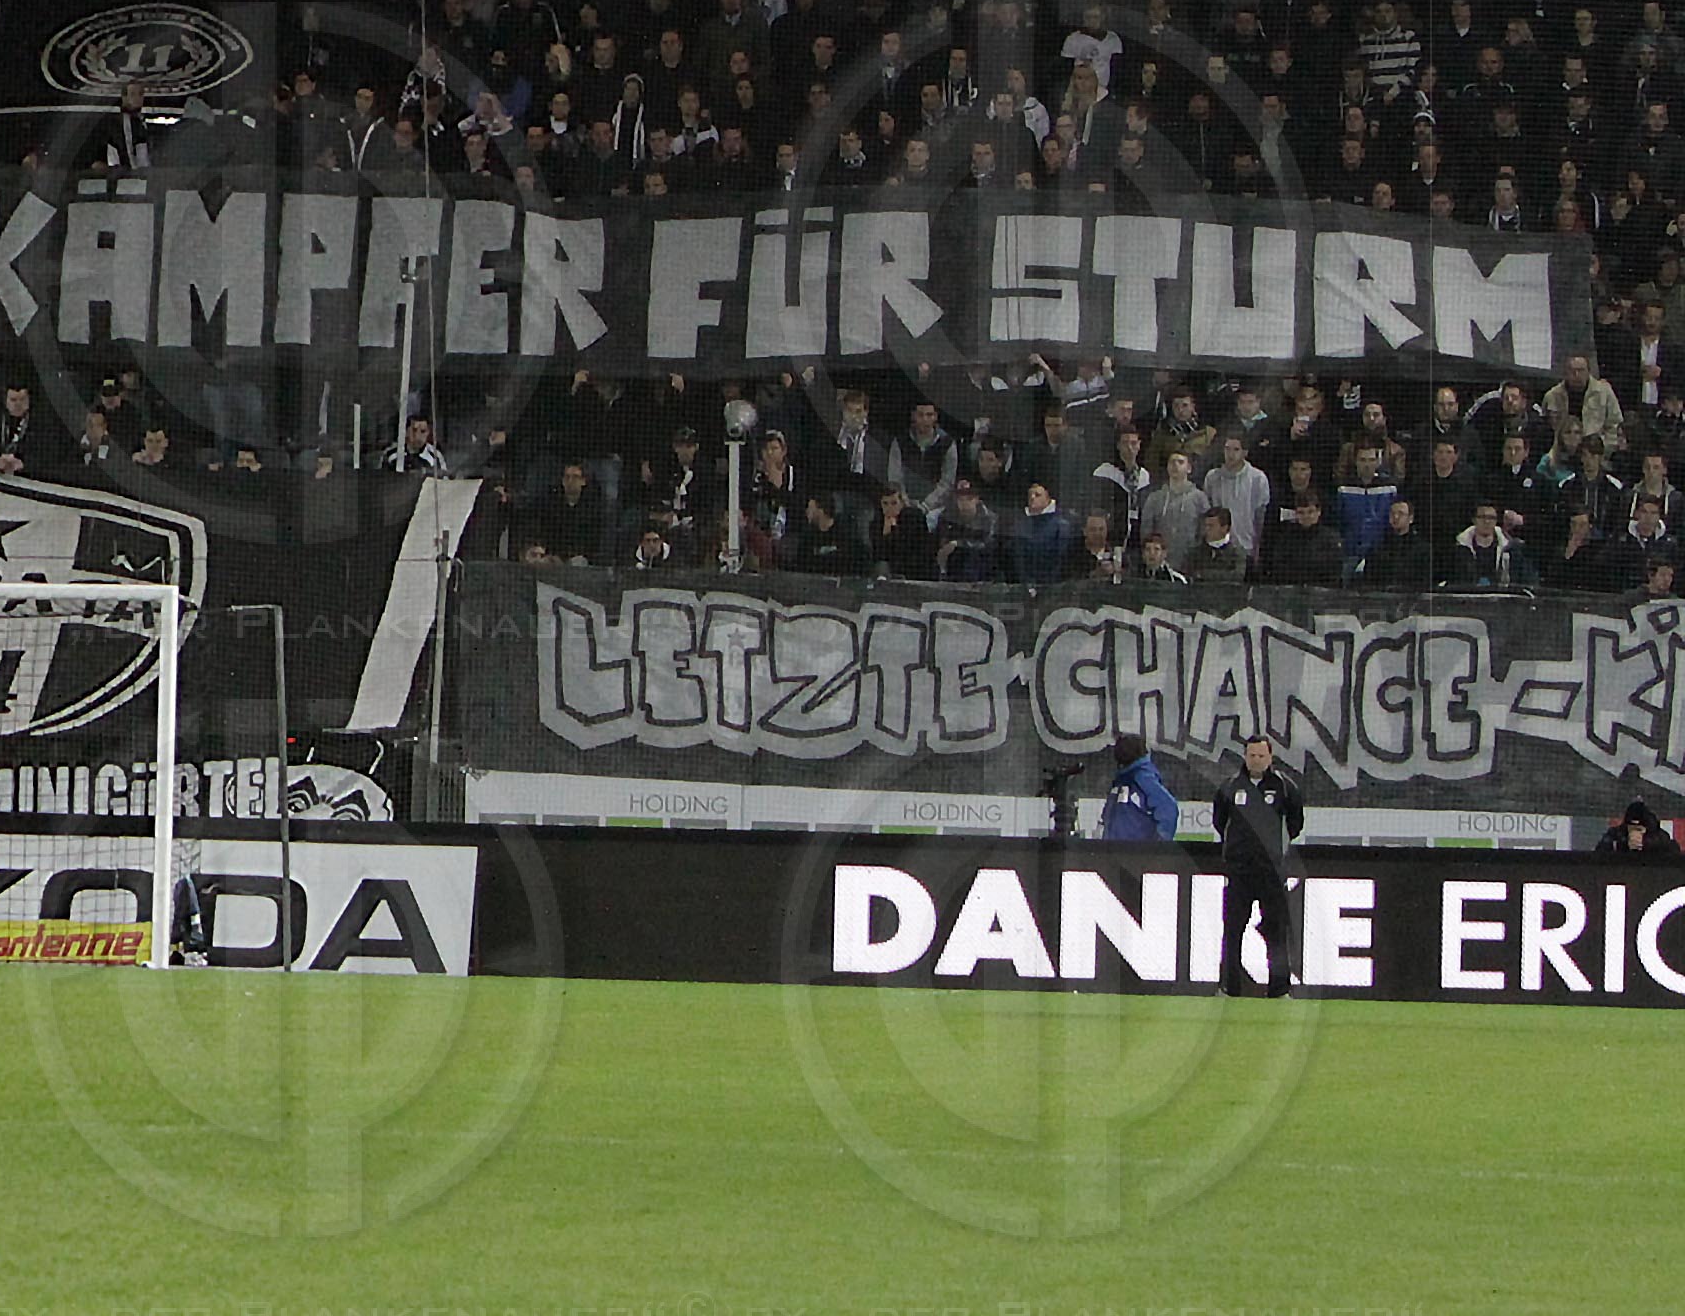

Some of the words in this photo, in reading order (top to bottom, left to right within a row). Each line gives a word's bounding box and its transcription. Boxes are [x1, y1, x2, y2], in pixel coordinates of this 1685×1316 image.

[646, 205, 945, 361] FÜR
[989, 214, 1554, 372] STURM
[537, 581, 1010, 758] LETZTE
[630, 793, 729, 815] HOLDING
[903, 802, 1003, 823] HOLDING
[1457, 813, 1559, 834] HOLDING
[832, 864, 1375, 987] DANKE
